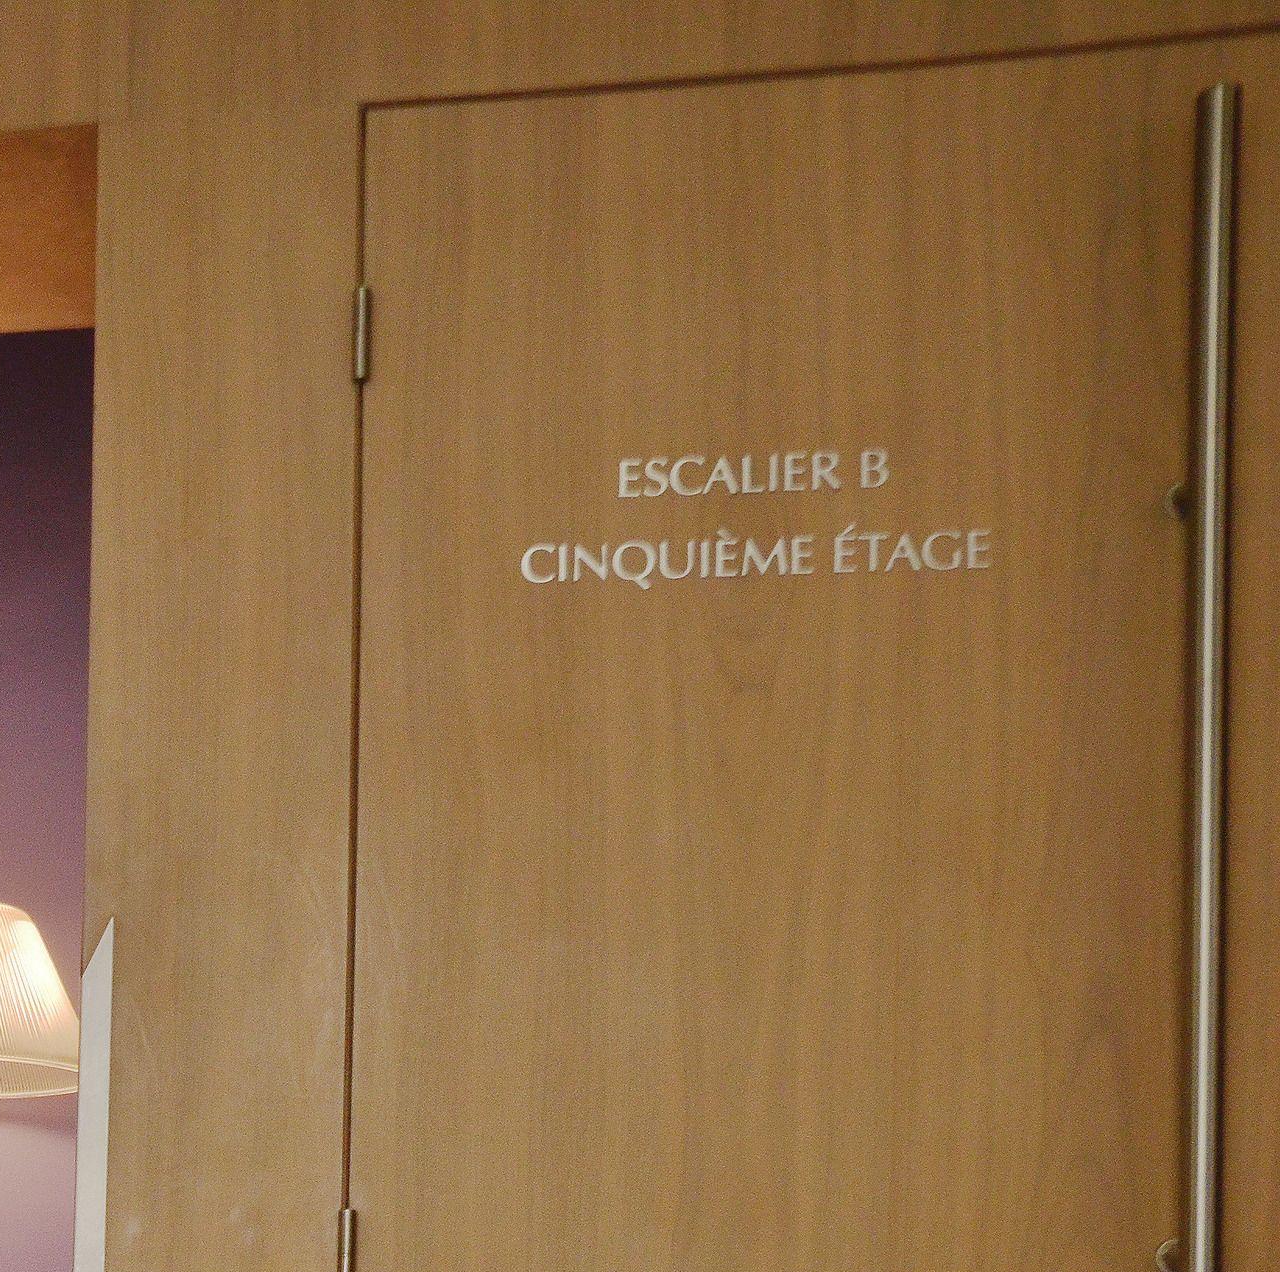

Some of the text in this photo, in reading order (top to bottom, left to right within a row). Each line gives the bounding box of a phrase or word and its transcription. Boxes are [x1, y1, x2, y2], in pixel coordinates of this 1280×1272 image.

[618, 448, 891, 499] ESCALIER B
[520, 522, 992, 590] CINQUIÈME ÉTAGE
